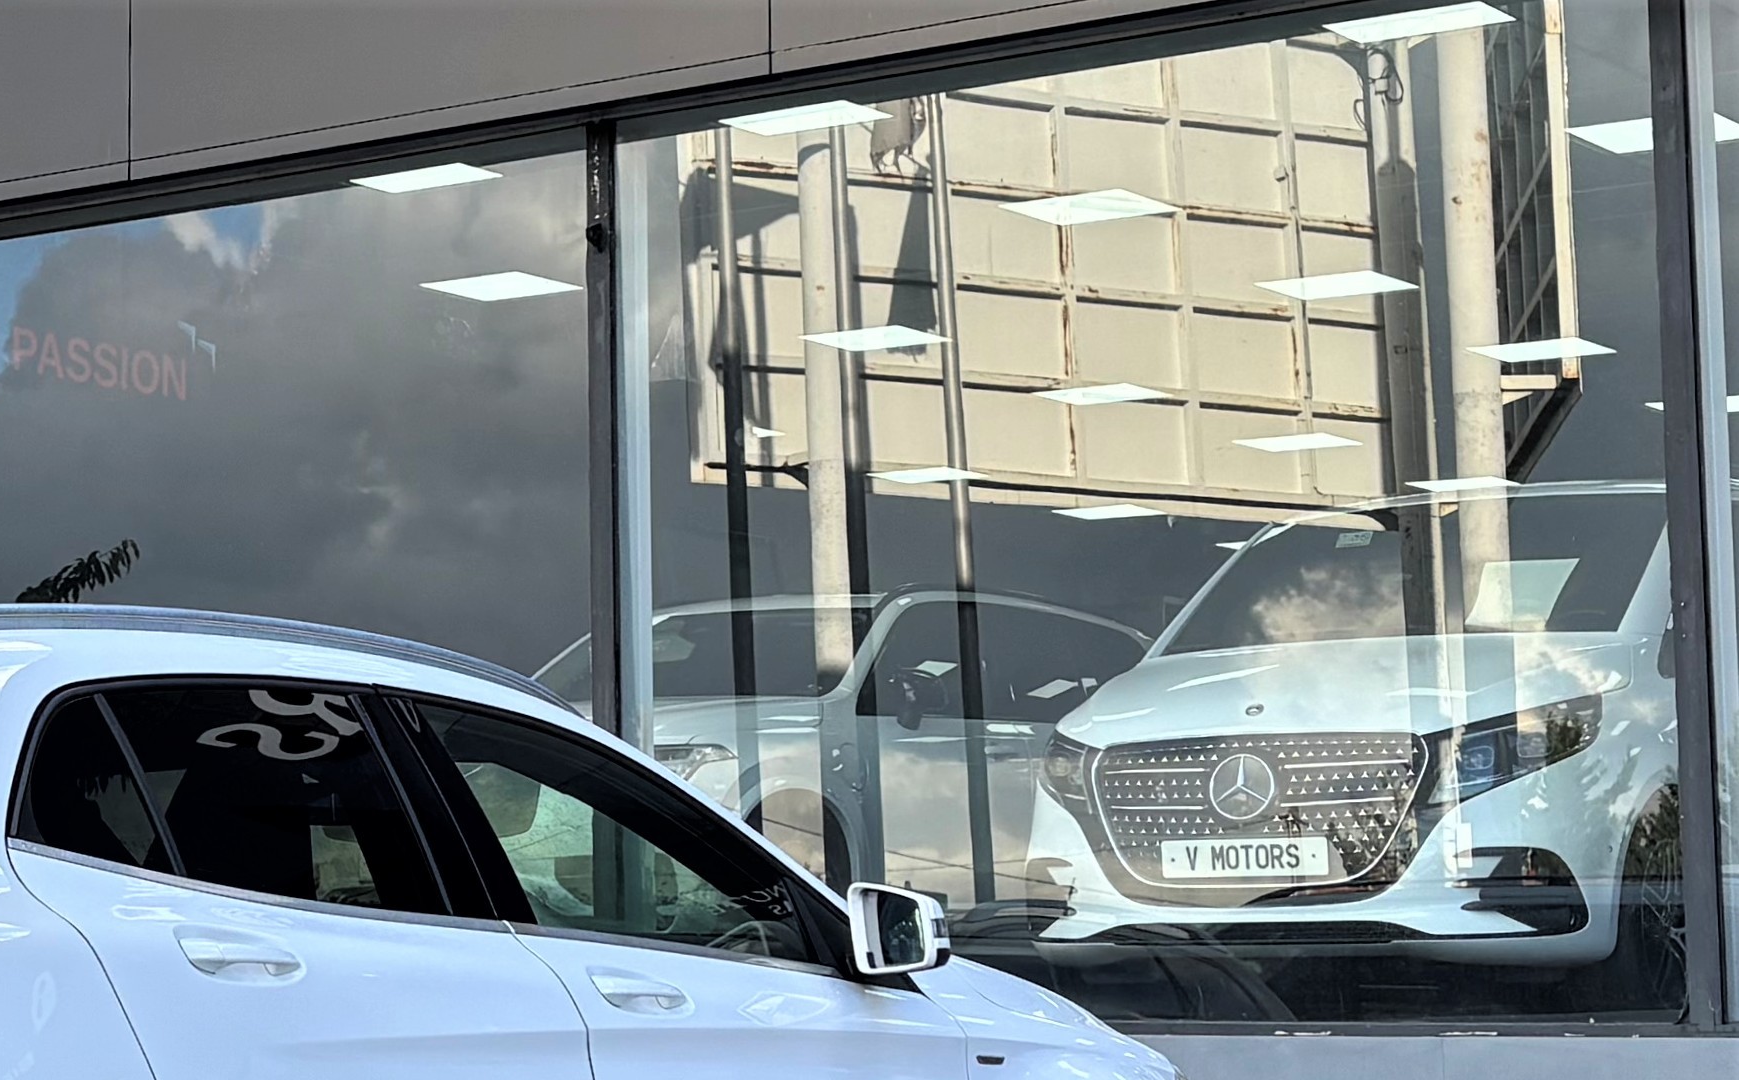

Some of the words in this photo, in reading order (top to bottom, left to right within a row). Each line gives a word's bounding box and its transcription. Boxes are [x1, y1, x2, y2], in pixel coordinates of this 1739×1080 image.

[12, 326, 188, 401] PASSION
[1185, 845, 1198, 872] V
[1211, 843, 1301, 871] MOTORS
